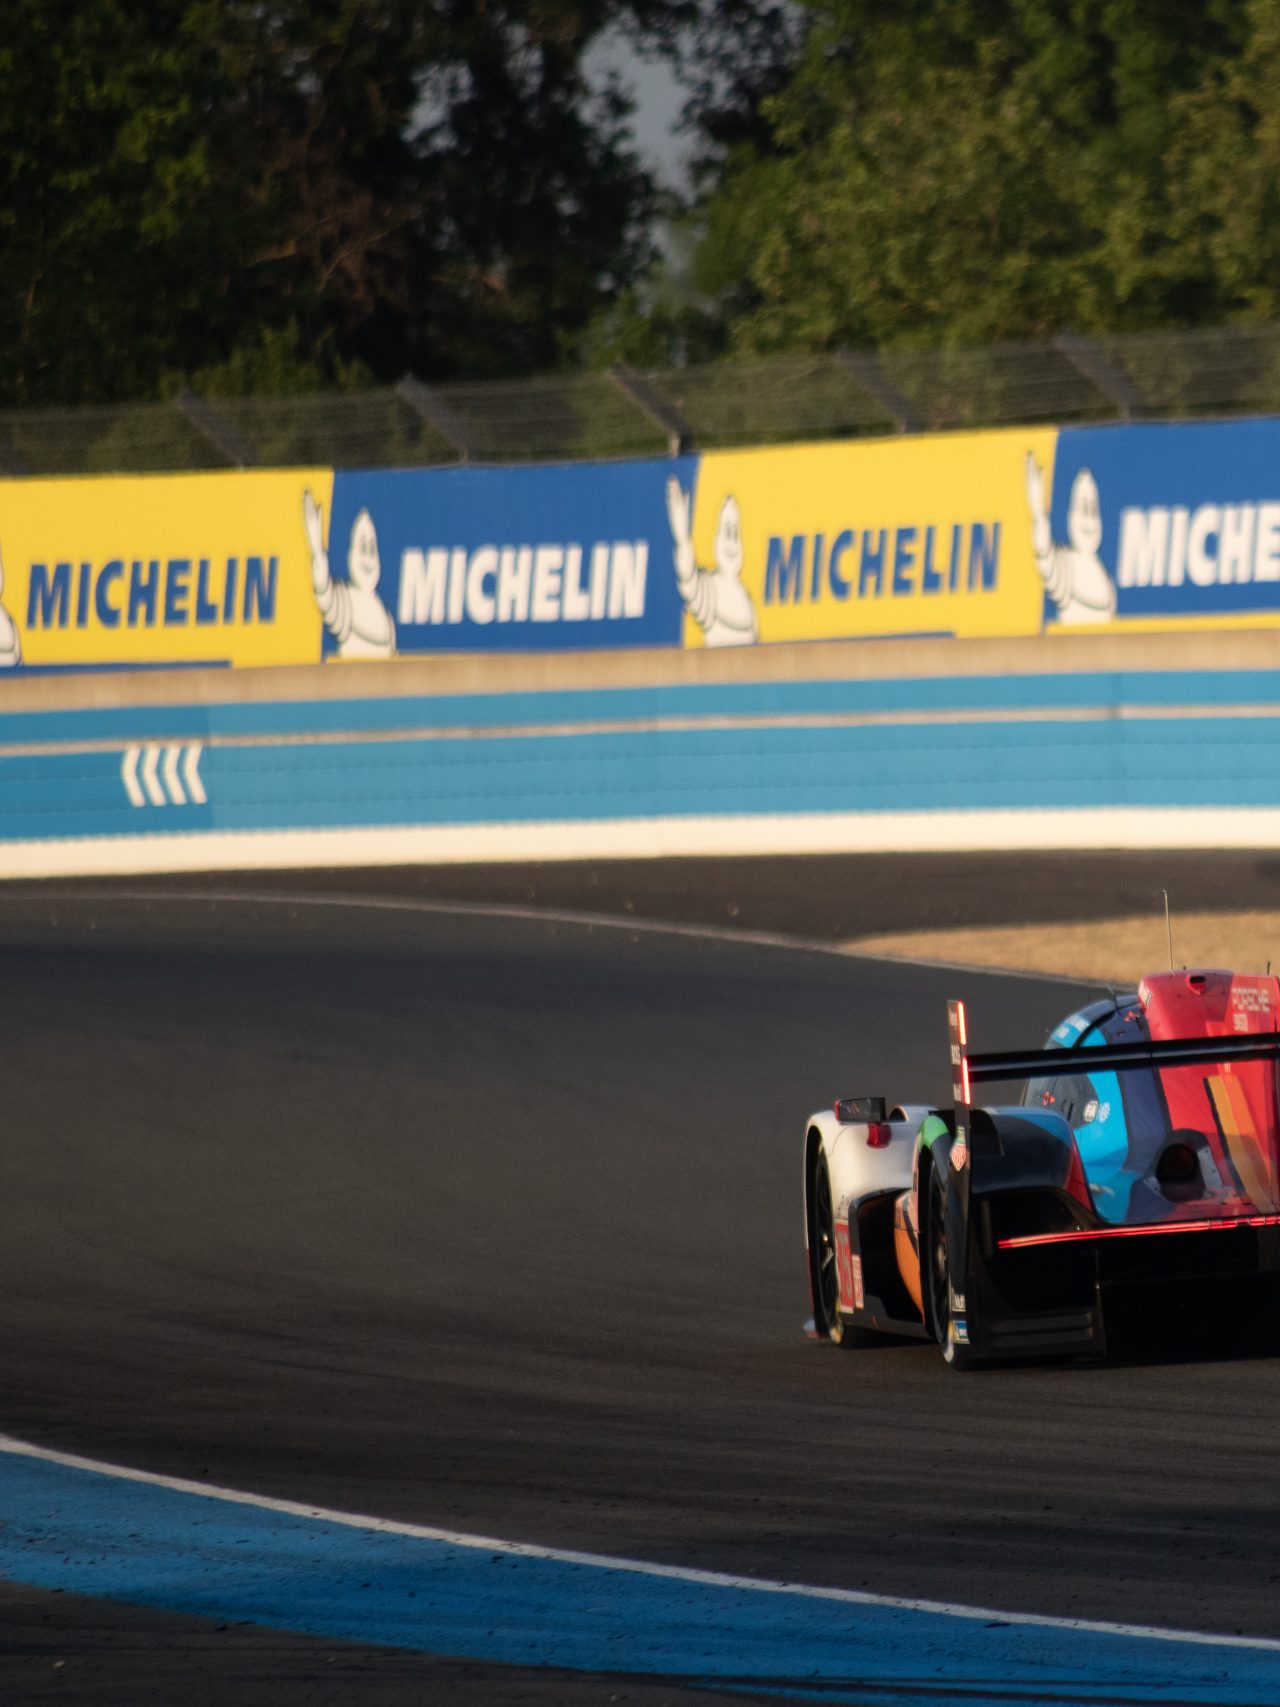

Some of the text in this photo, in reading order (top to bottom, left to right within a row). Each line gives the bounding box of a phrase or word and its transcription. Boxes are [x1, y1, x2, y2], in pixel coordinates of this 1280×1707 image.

[26, 556, 278, 628] MICHELIN
[398, 541, 649, 624] MICHELIN
[763, 521, 1001, 607] MICHELIN
